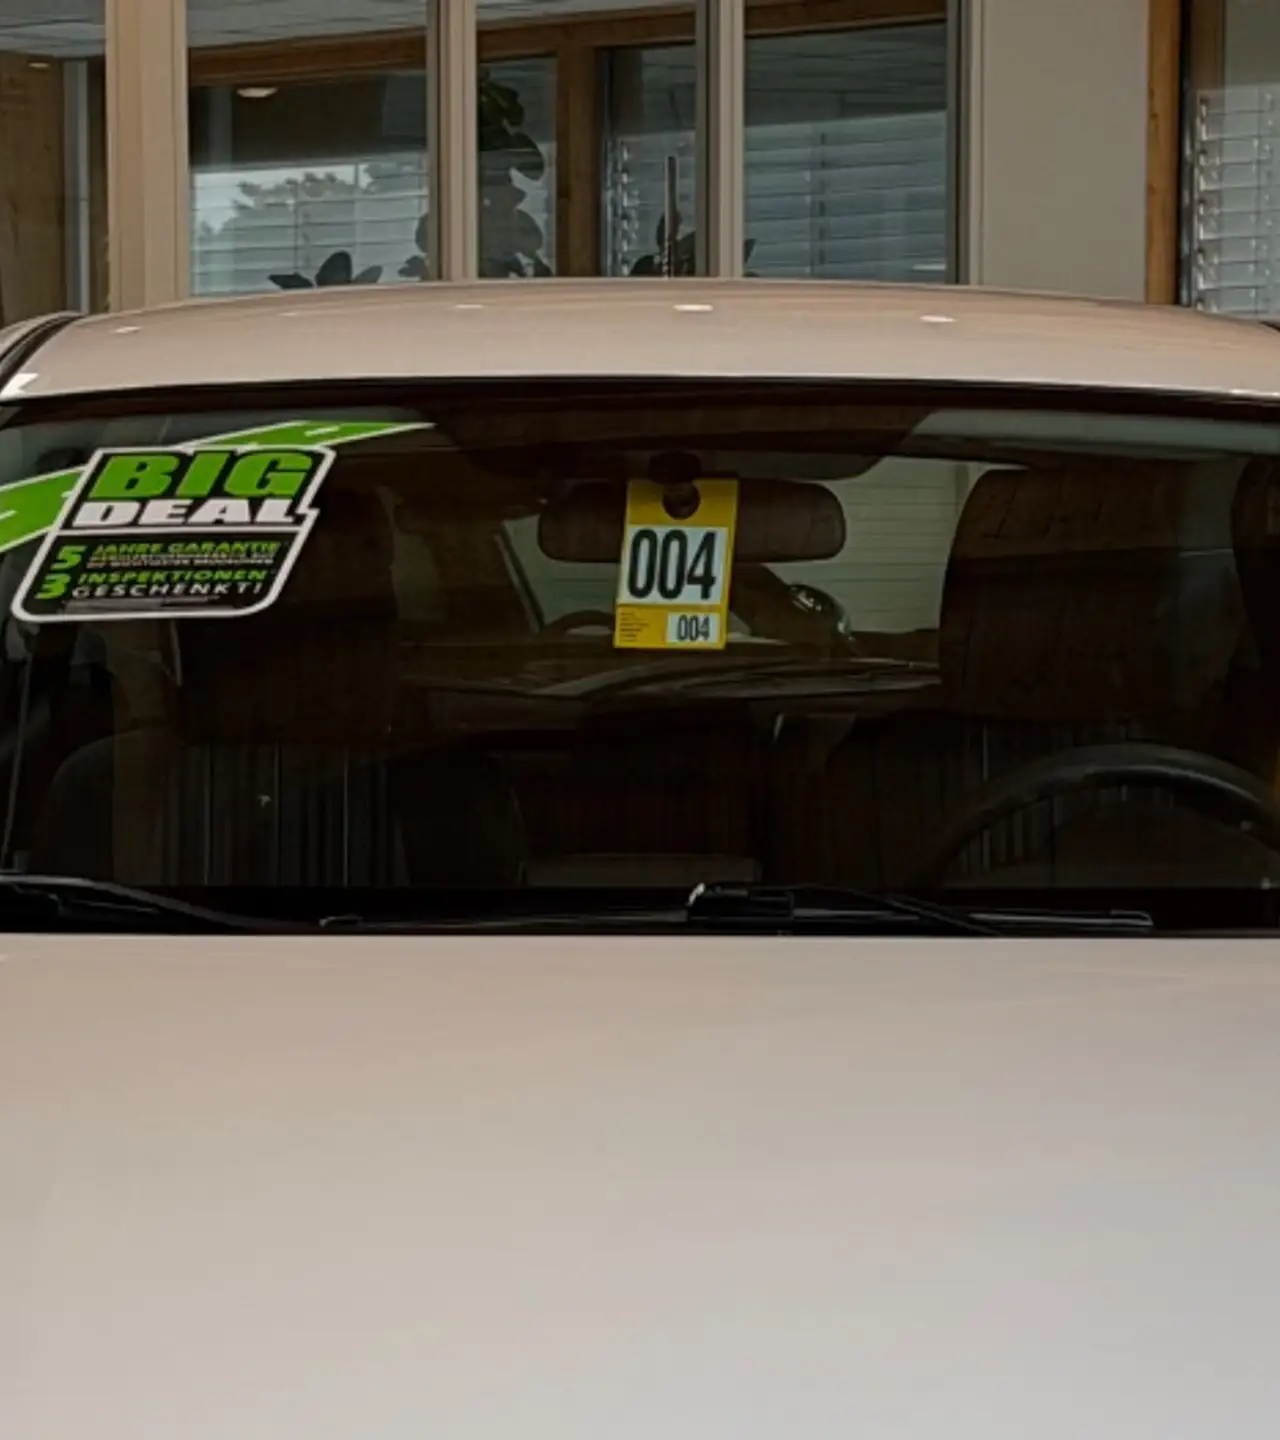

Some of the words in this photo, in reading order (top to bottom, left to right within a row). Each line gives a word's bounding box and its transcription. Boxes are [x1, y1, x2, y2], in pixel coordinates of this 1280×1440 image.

[89, 452, 313, 498] BIG
[71, 499, 299, 527] DEAL
[53, 545, 87, 570] 5
[628, 529, 717, 600] 004
[36, 573, 69, 599] 3
[676, 614, 710, 642] 004
